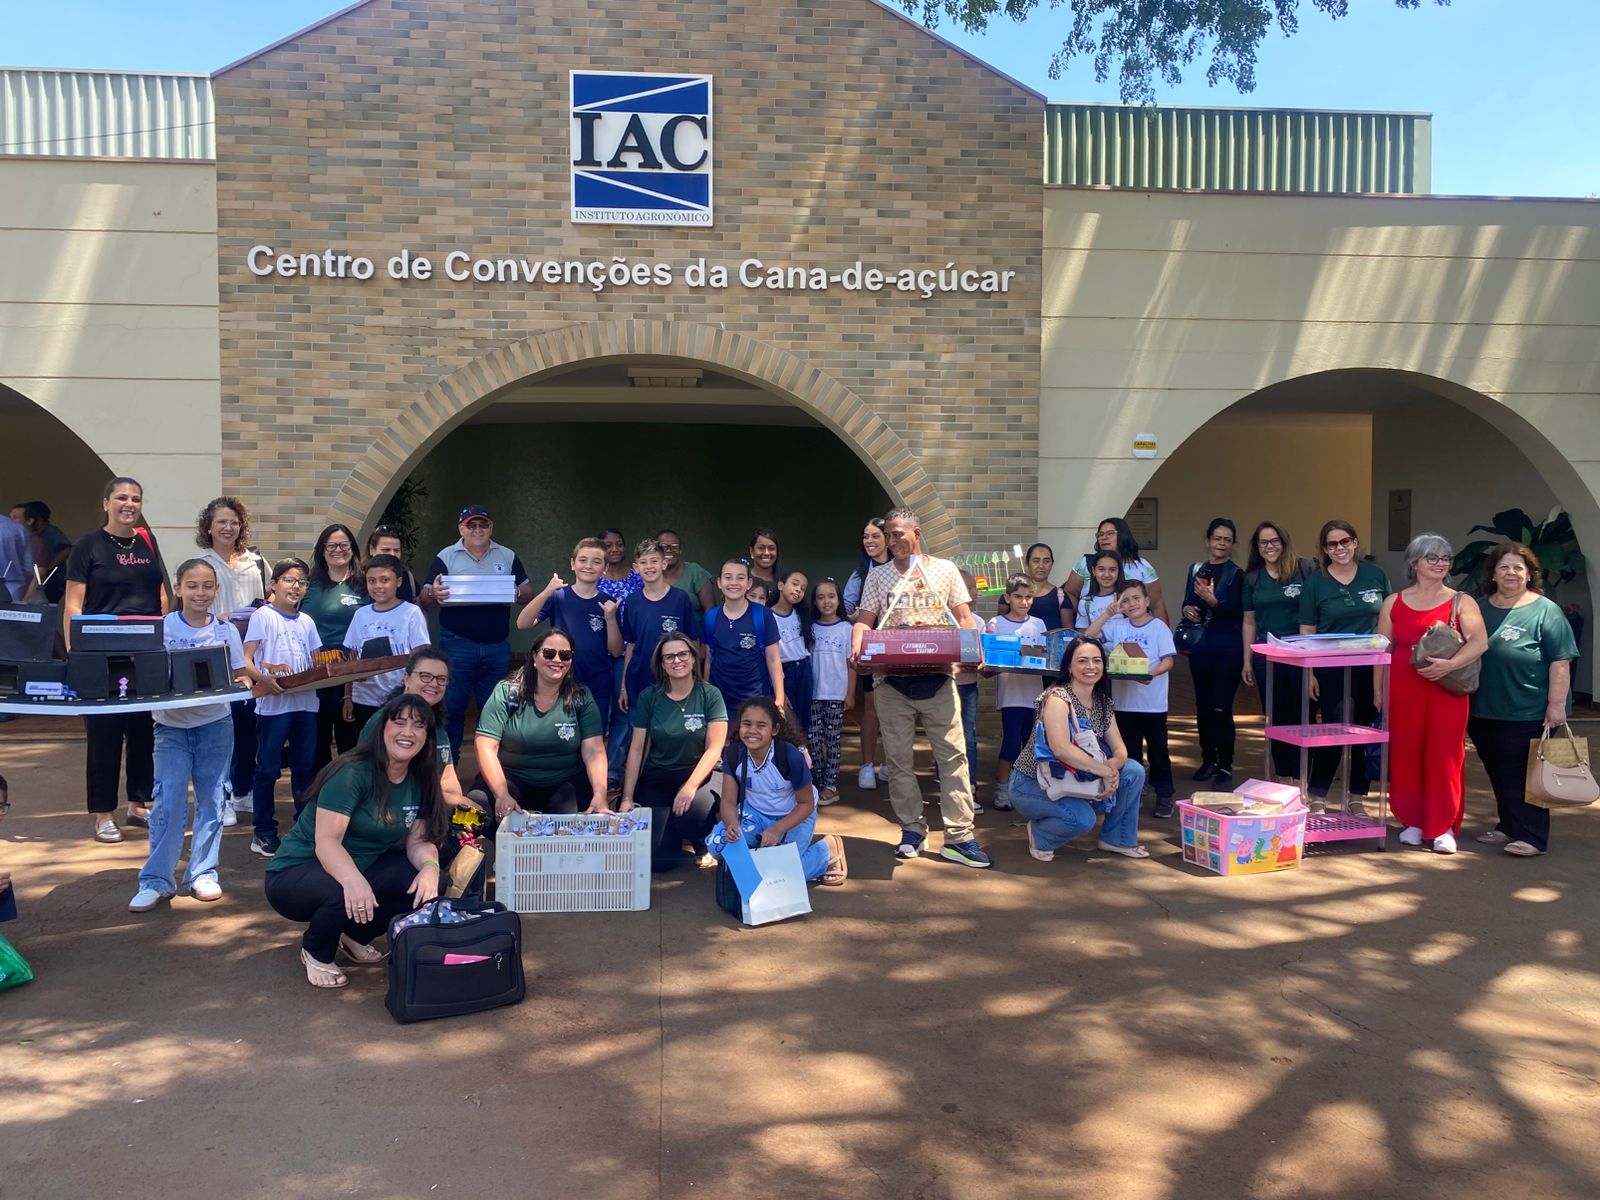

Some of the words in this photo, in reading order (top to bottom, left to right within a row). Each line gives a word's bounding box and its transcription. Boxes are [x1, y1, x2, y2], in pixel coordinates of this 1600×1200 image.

[573, 112, 709, 171] IAC
[575, 211, 634, 220] INSTITUTO
[634, 211, 710, 222] AGRONÔMICO
[247, 245, 375, 280] Centro
[387, 249, 432, 279] de
[444, 251, 673, 292] Convenções
[684, 257, 729, 288] da
[738, 258, 1015, 299] Cana-de-açúcar
